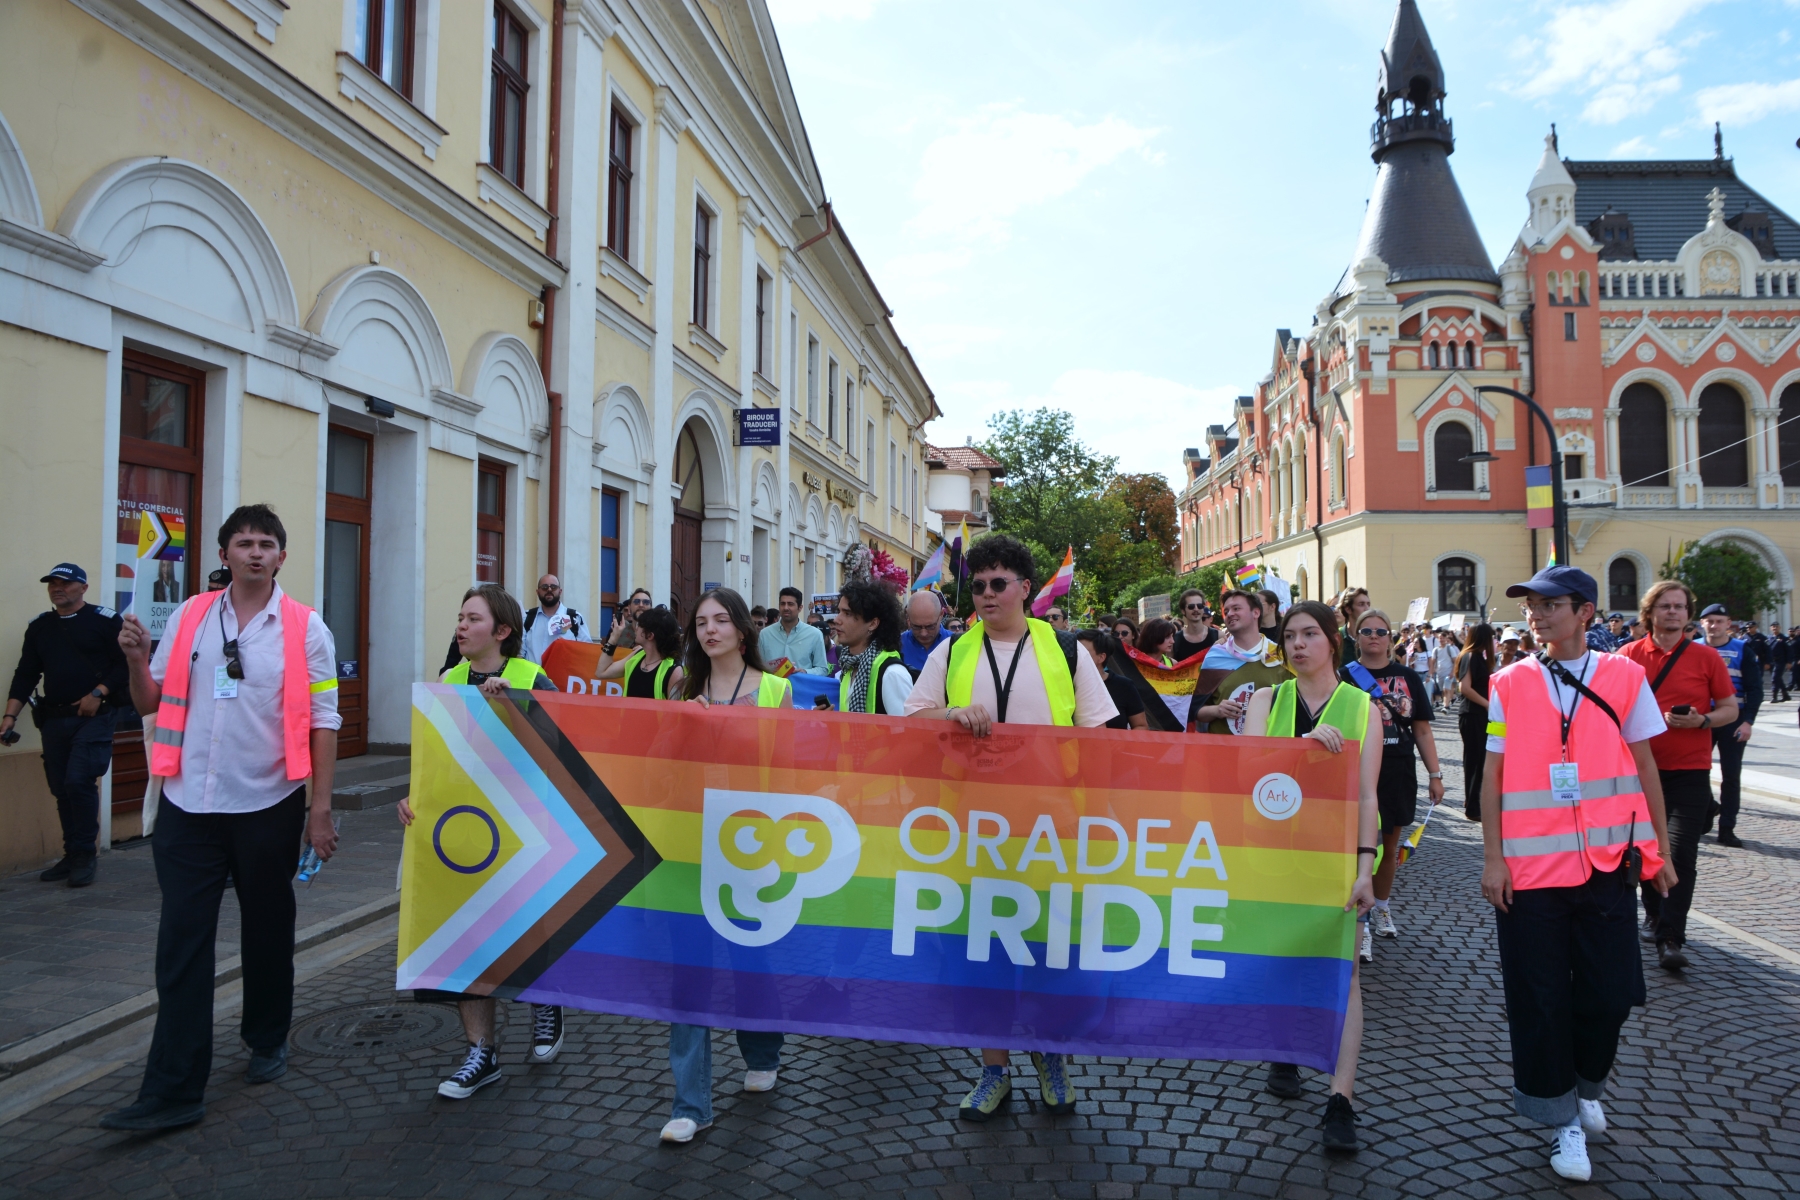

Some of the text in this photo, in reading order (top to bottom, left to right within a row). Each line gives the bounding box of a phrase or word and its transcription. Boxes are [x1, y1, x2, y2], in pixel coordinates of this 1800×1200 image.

[117, 499, 184, 516] AȚIU COMERCIAL
[119, 510, 142, 520] DE ÎN
[477, 553, 497, 561] COMERCIAL
[151, 620, 168, 629] ANT
[1266, 790, 1289, 802] Ark
[900, 806, 1228, 880] ORADEA
[891, 870, 1229, 979] PRIDE
